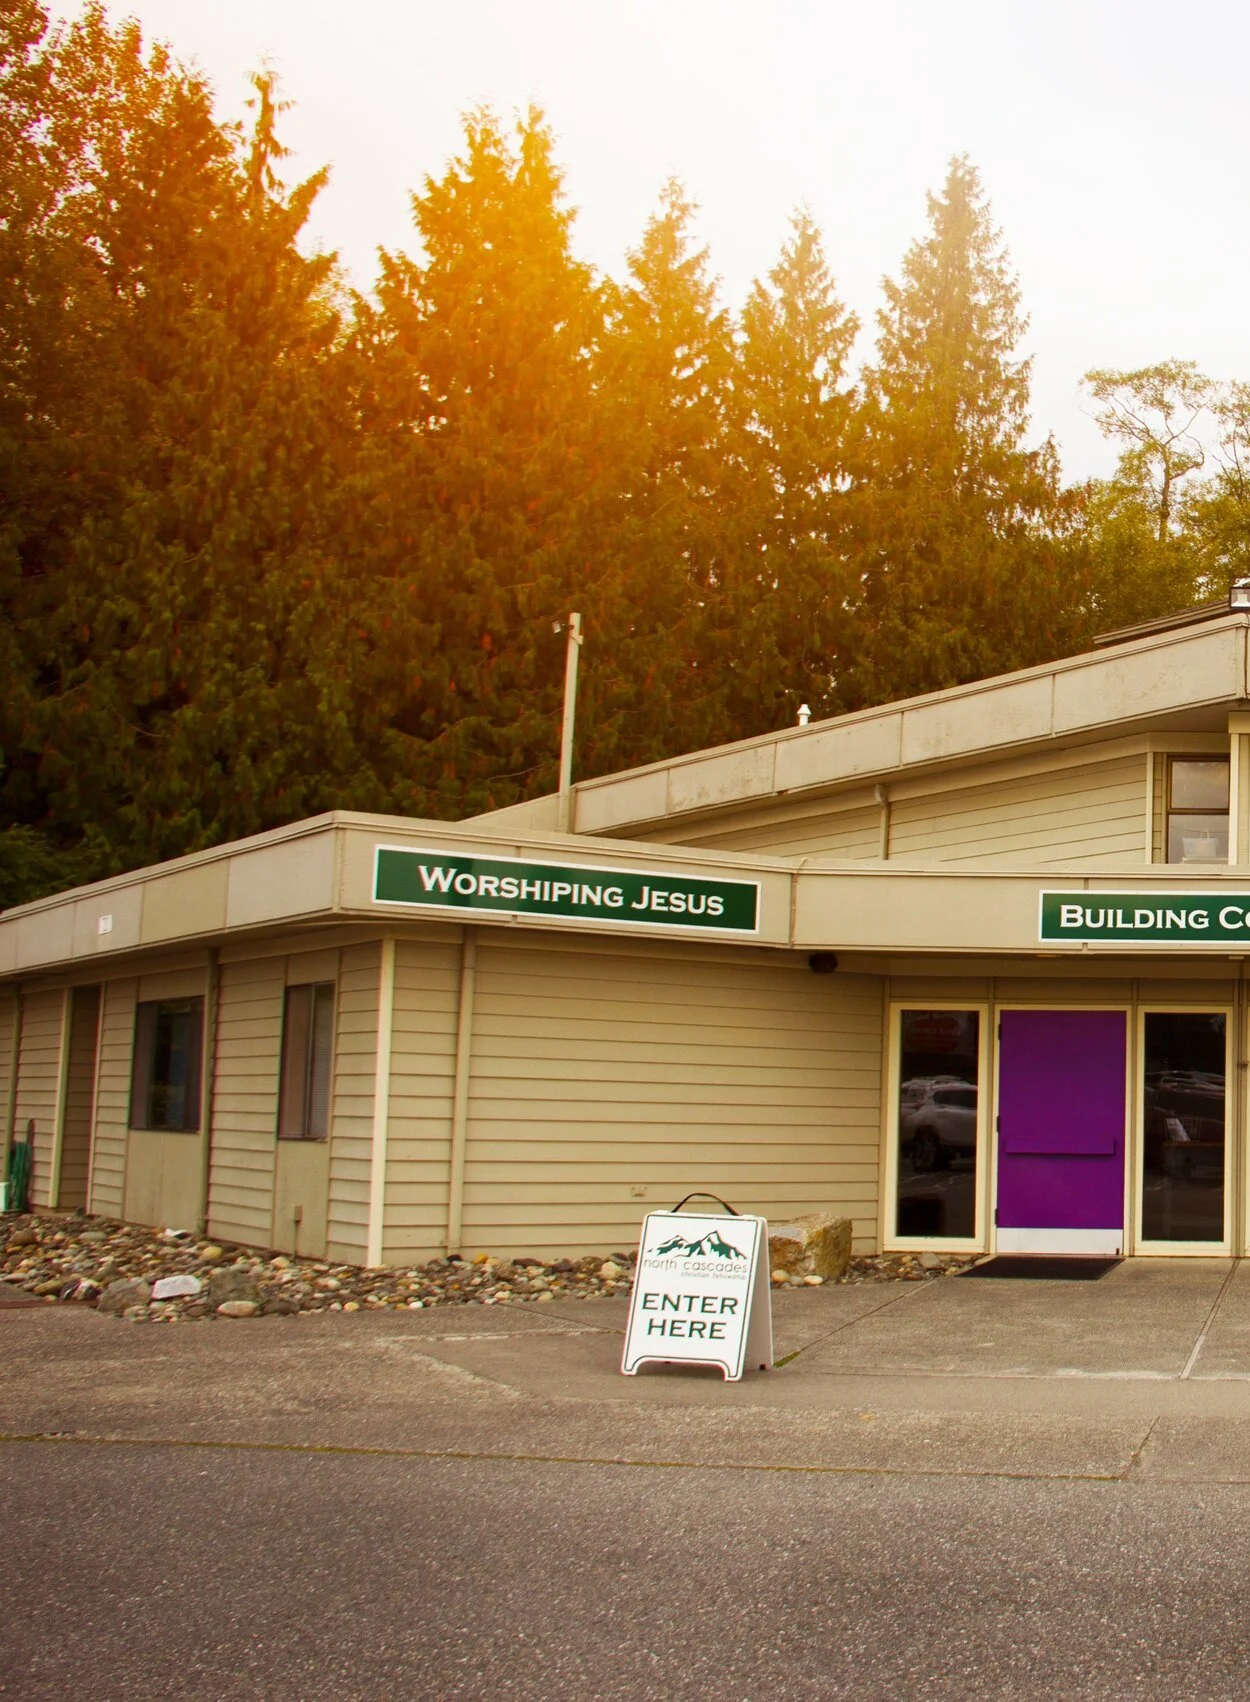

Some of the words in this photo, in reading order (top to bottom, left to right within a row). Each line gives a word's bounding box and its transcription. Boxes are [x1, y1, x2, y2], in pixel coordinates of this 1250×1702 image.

[417, 865, 624, 908] WORSHIPING
[631, 886, 724, 916] JESUS
[1060, 904, 1210, 929] BUILDING
[643, 1258, 677, 1271] north
[683, 1261, 748, 1274] cascades
[641, 1292, 738, 1314] ENTER
[647, 1318, 727, 1340] HERE
